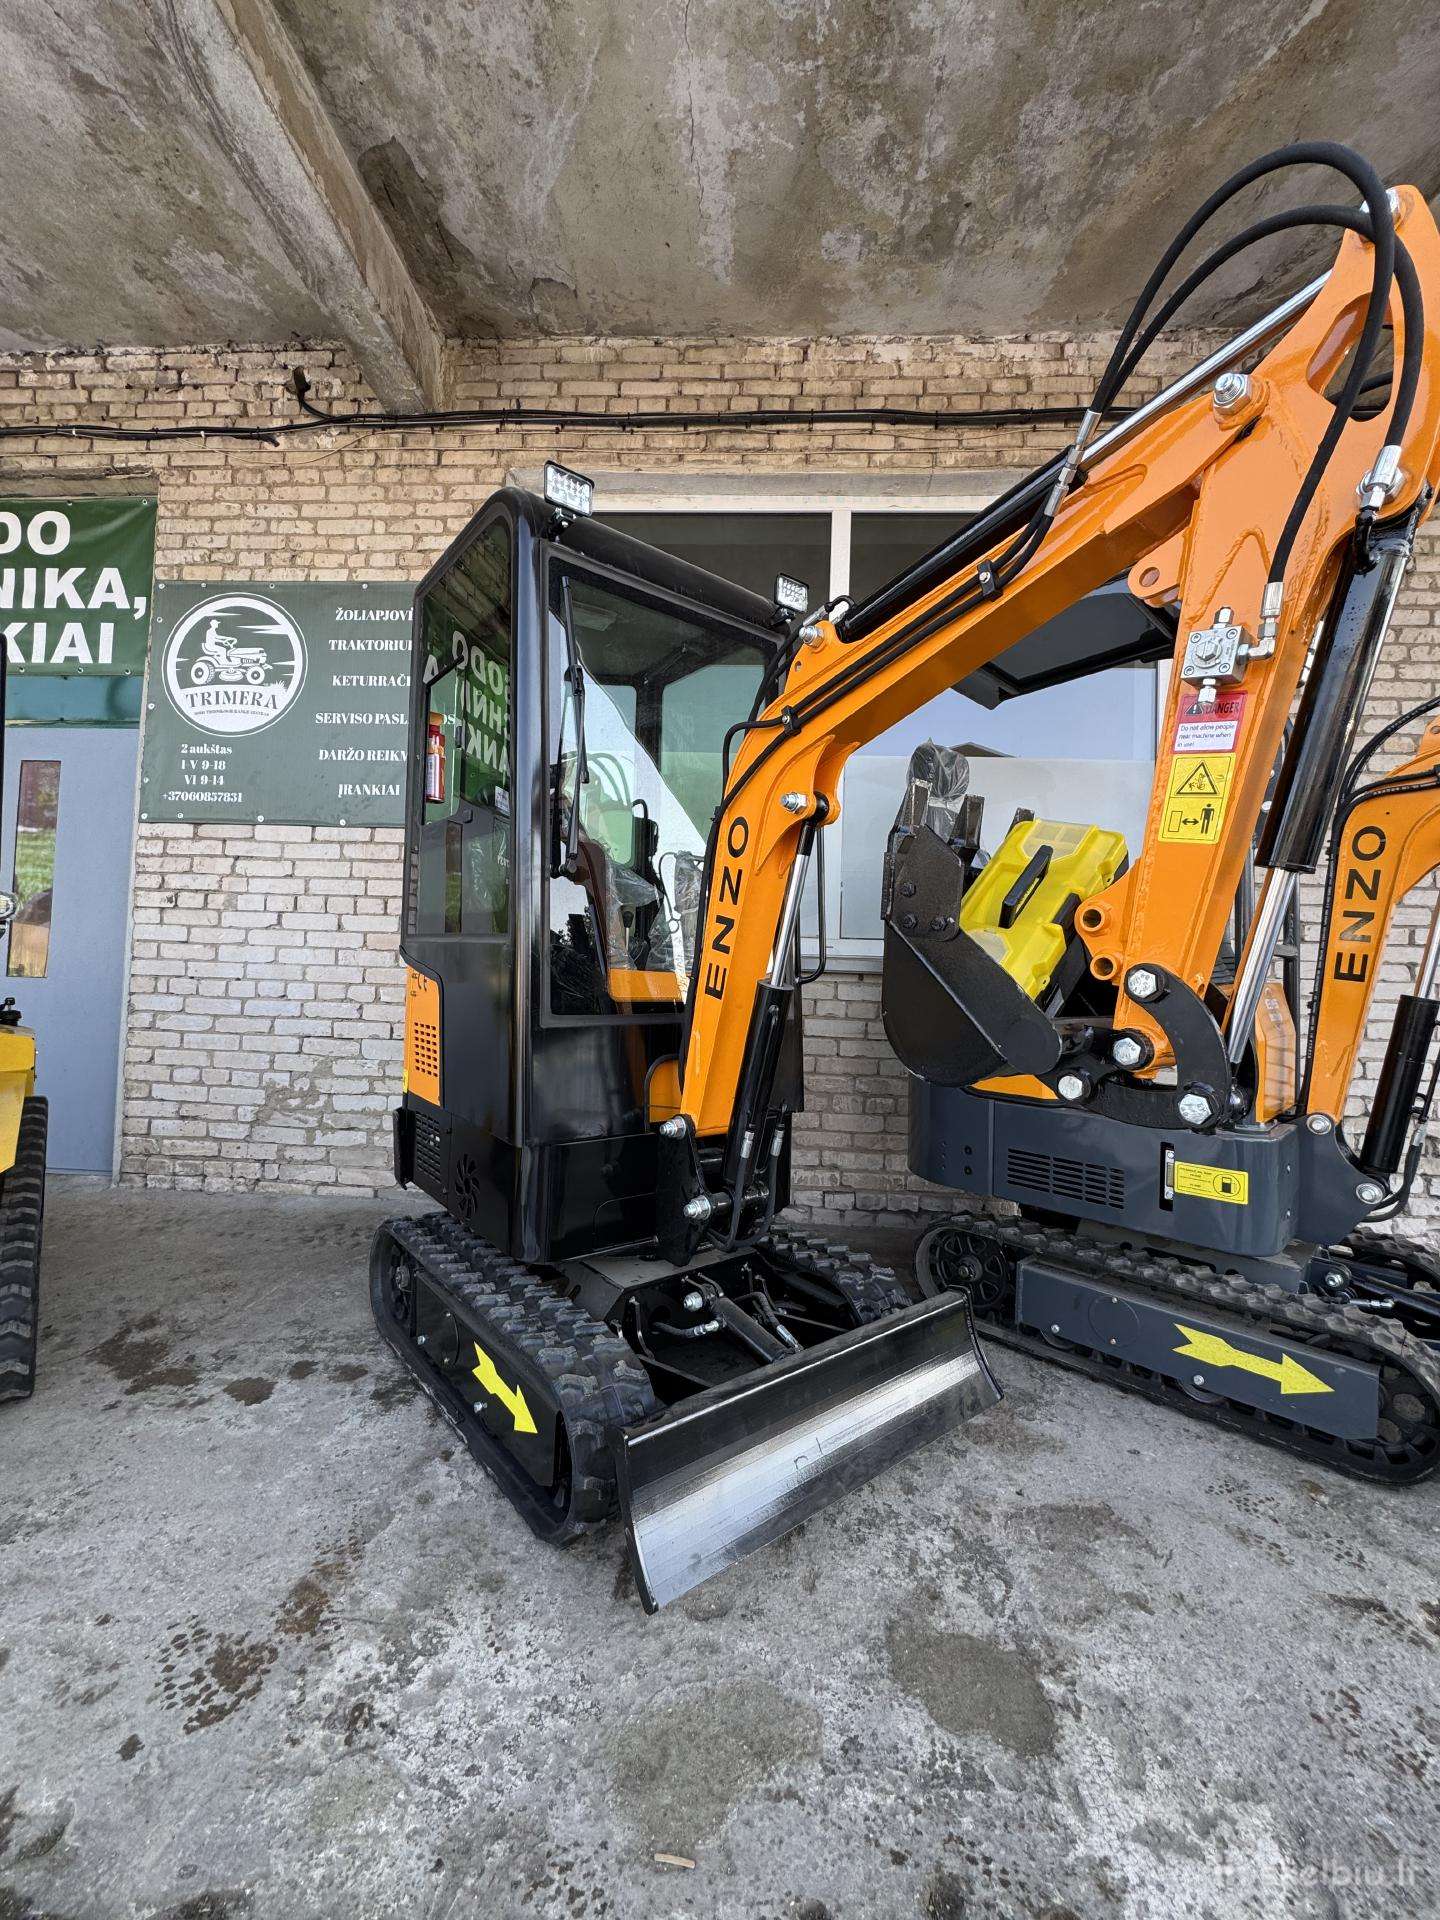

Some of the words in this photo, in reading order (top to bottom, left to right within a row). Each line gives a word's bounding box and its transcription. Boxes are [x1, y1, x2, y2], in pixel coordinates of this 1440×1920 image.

[185, 690, 279, 710] TRIMERA
[1202, 702, 1241, 714] DANGER
[315, 712, 373, 724] SERVISO
[180, 743, 188, 754] 2
[190, 743, 233, 754] aukštas
[318, 747, 365, 761] DARŽO
[201, 760, 226, 770] 9-18
[184, 774, 197, 785] VI
[200, 774, 225, 786] 9-14
[337, 783, 401, 798] ĮRANKIAI
[704, 816, 749, 1001] ENZO
[1333, 825, 1387, 983] ENZO
